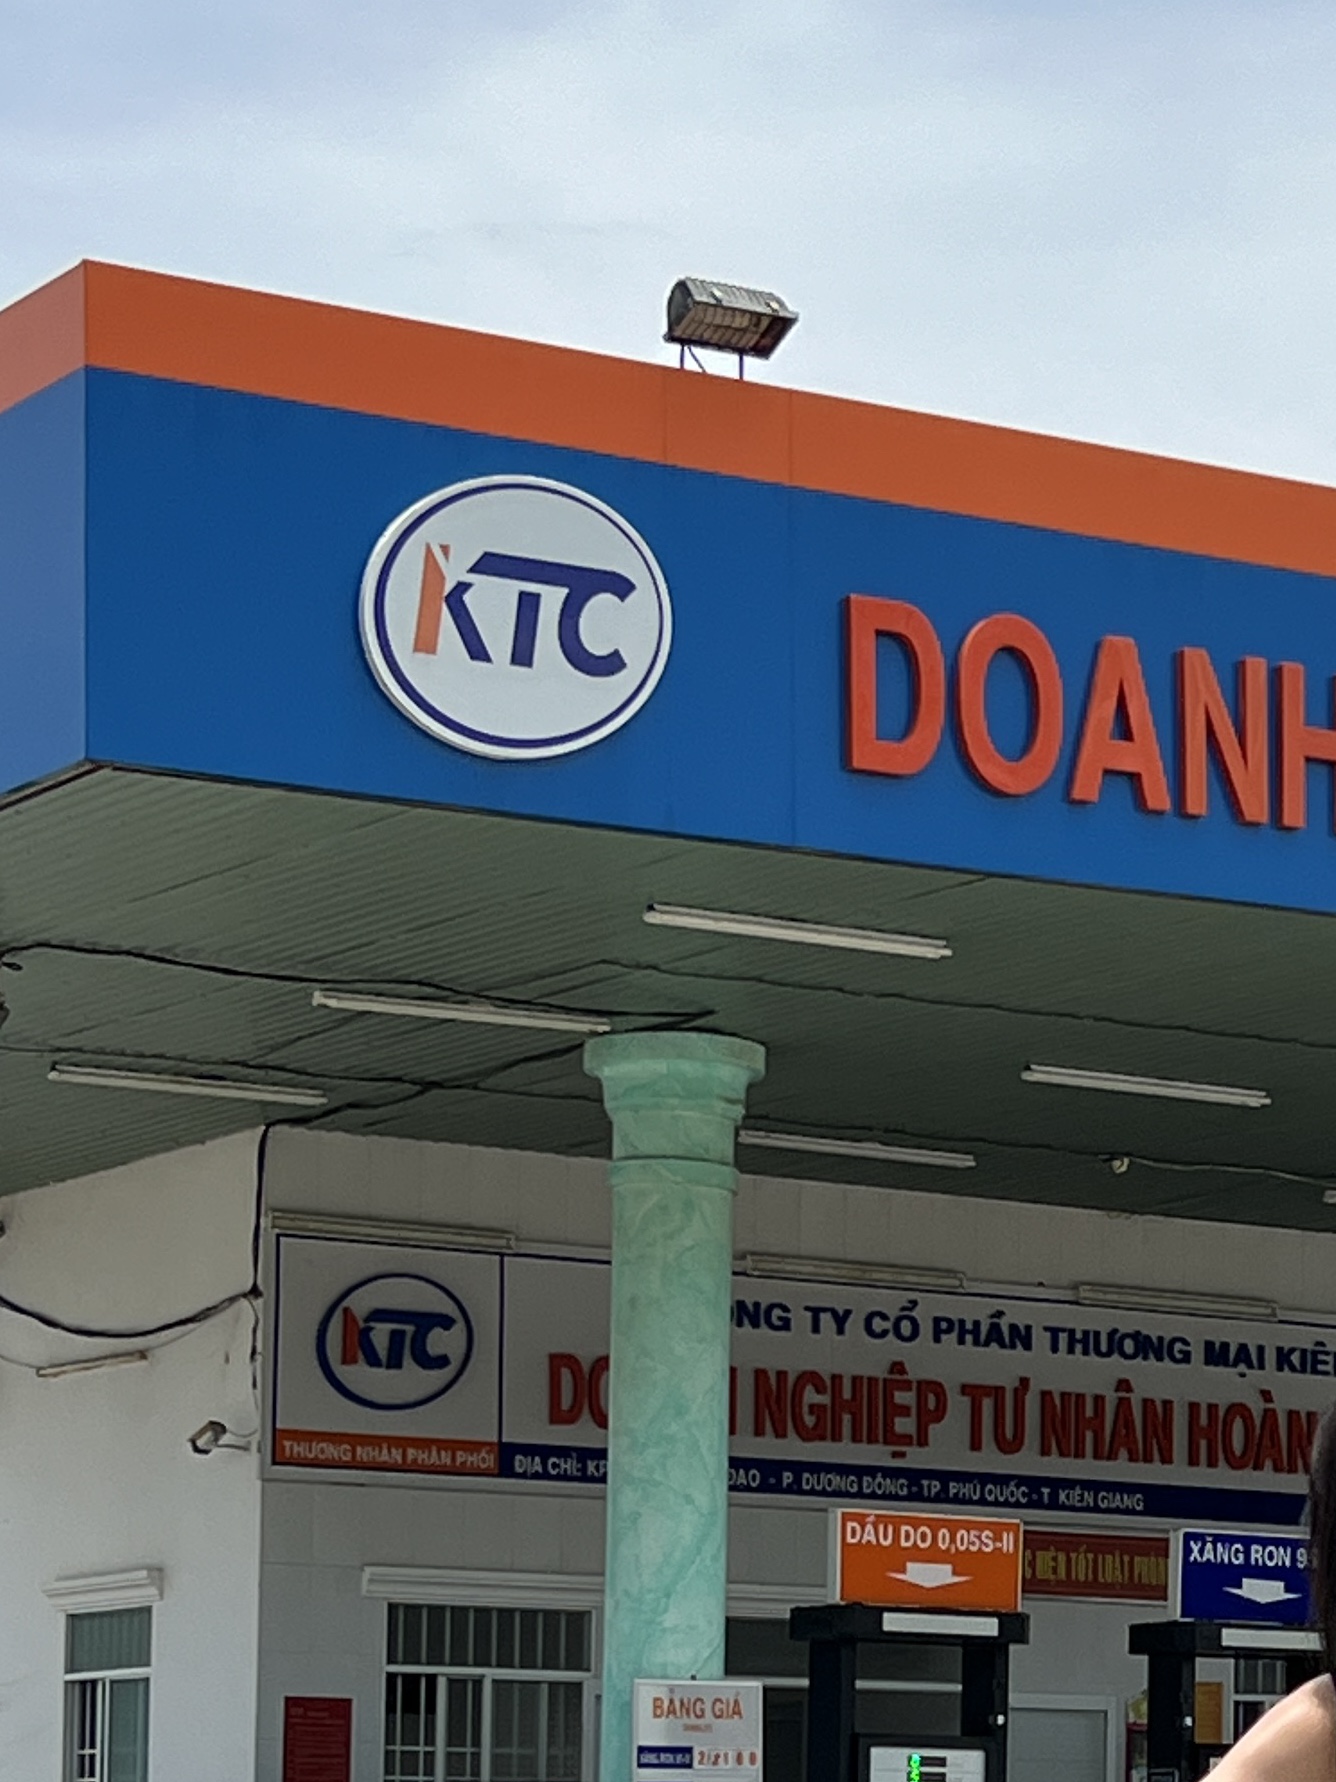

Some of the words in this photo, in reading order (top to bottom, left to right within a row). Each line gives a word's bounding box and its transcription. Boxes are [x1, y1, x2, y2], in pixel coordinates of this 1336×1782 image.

[413, 542, 637, 678] KTC
[341, 1306, 456, 1370] KTC
[730, 1299, 792, 1333] NG
[804, 1304, 852, 1336] TY
[864, 1299, 920, 1343] CỔ
[1042, 1326, 1192, 1365] THƯƠNG
[1203, 1340, 1266, 1378] MẠI
[754, 1360, 948, 1459] NGHIỆP
[960, 1376, 1030, 1455] TƯ
[1040, 1378, 1174, 1466] NHÂN
[1188, 1389, 1318, 1475] HOÀN
[802, 1471, 858, 1492] DƯƠNG
[949, 1479, 980, 1501] PHÚ
[985, 1479, 1028, 1504] QUỐC
[1098, 1492, 1144, 1511] GIANG
[900, 1525, 932, 1549] DO
[938, 1529, 1014, 1554] 0,05S-II
[1189, 1535, 1245, 1566] XĂNG
[1250, 1543, 1292, 1568] RON
[711, 1691, 743, 1720] GIÁ
